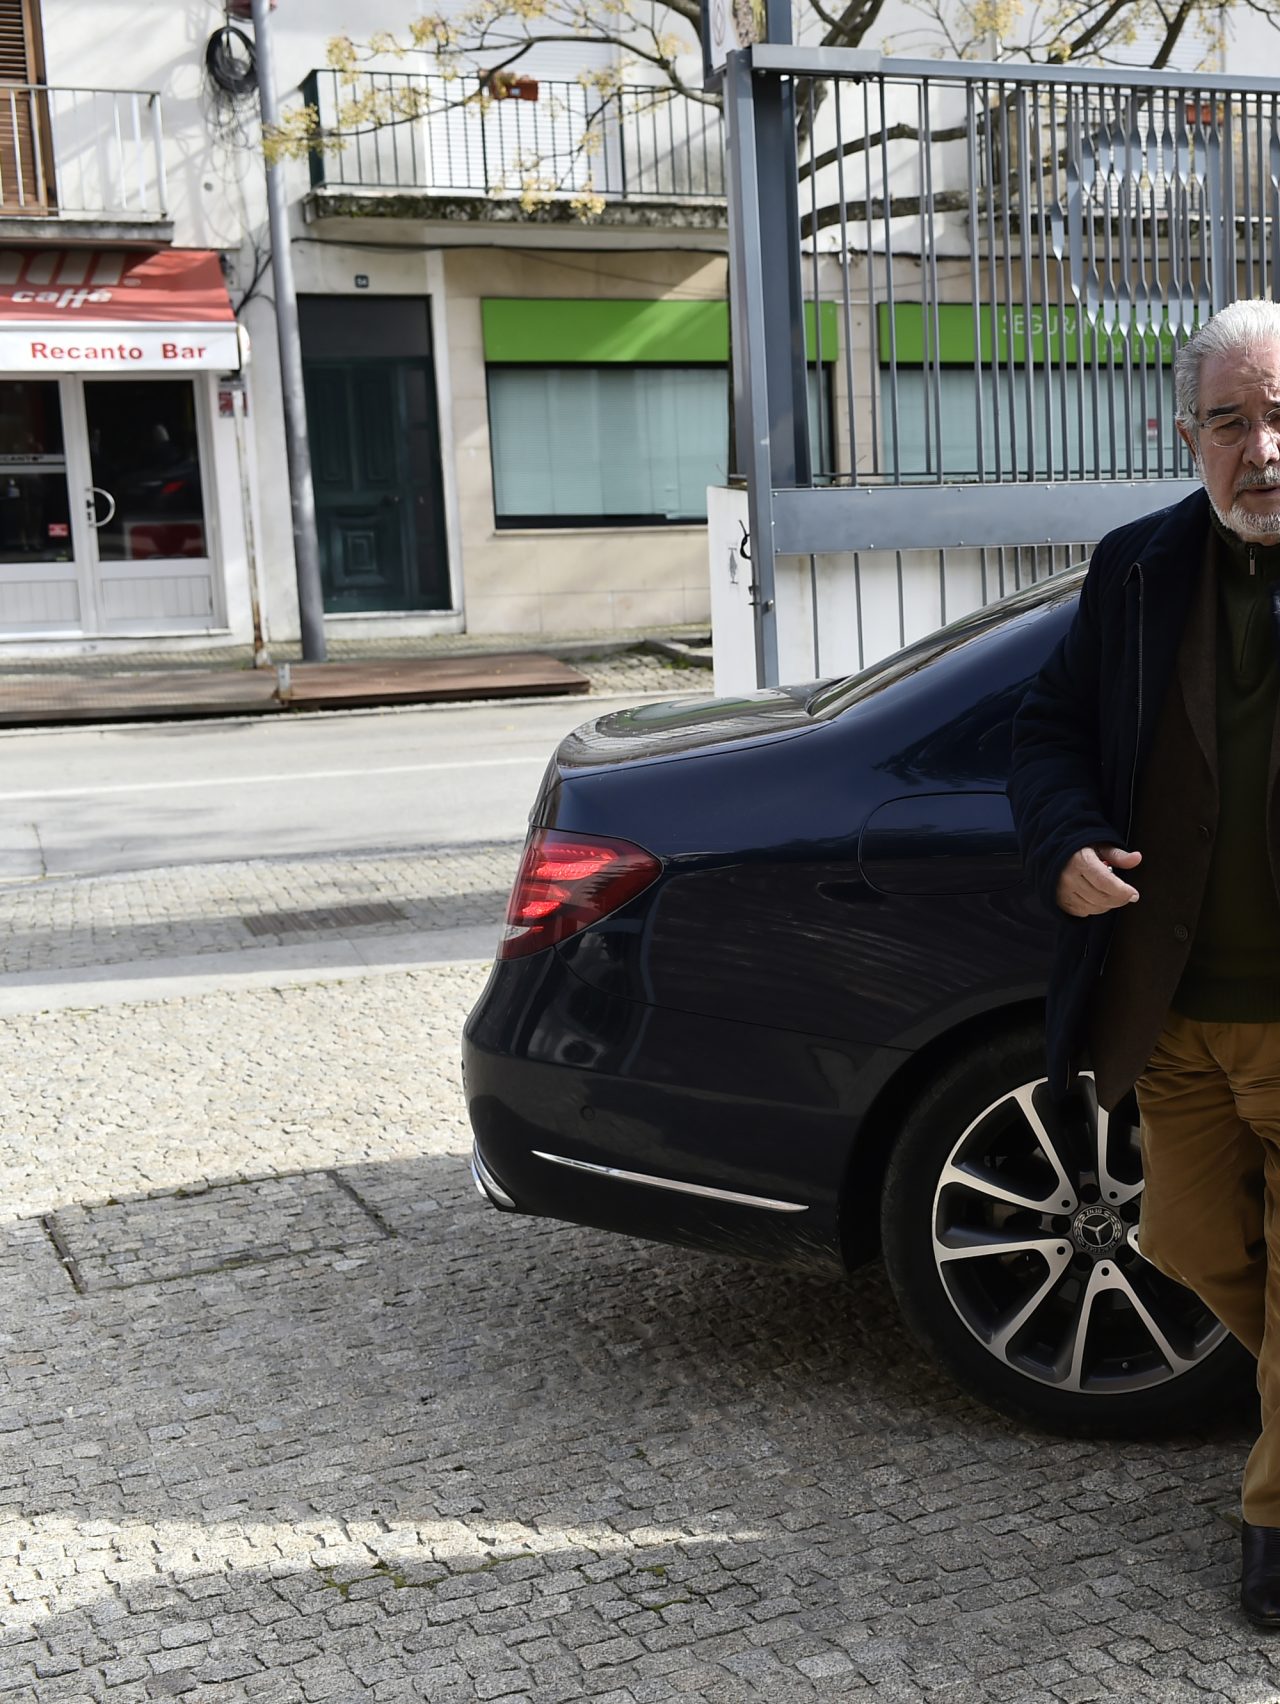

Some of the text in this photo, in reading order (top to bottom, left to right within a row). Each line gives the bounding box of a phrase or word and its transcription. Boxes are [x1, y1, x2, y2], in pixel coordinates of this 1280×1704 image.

[1002, 313, 1122, 337] SEGURAN
[30, 342, 207, 360] Recanto Bar
